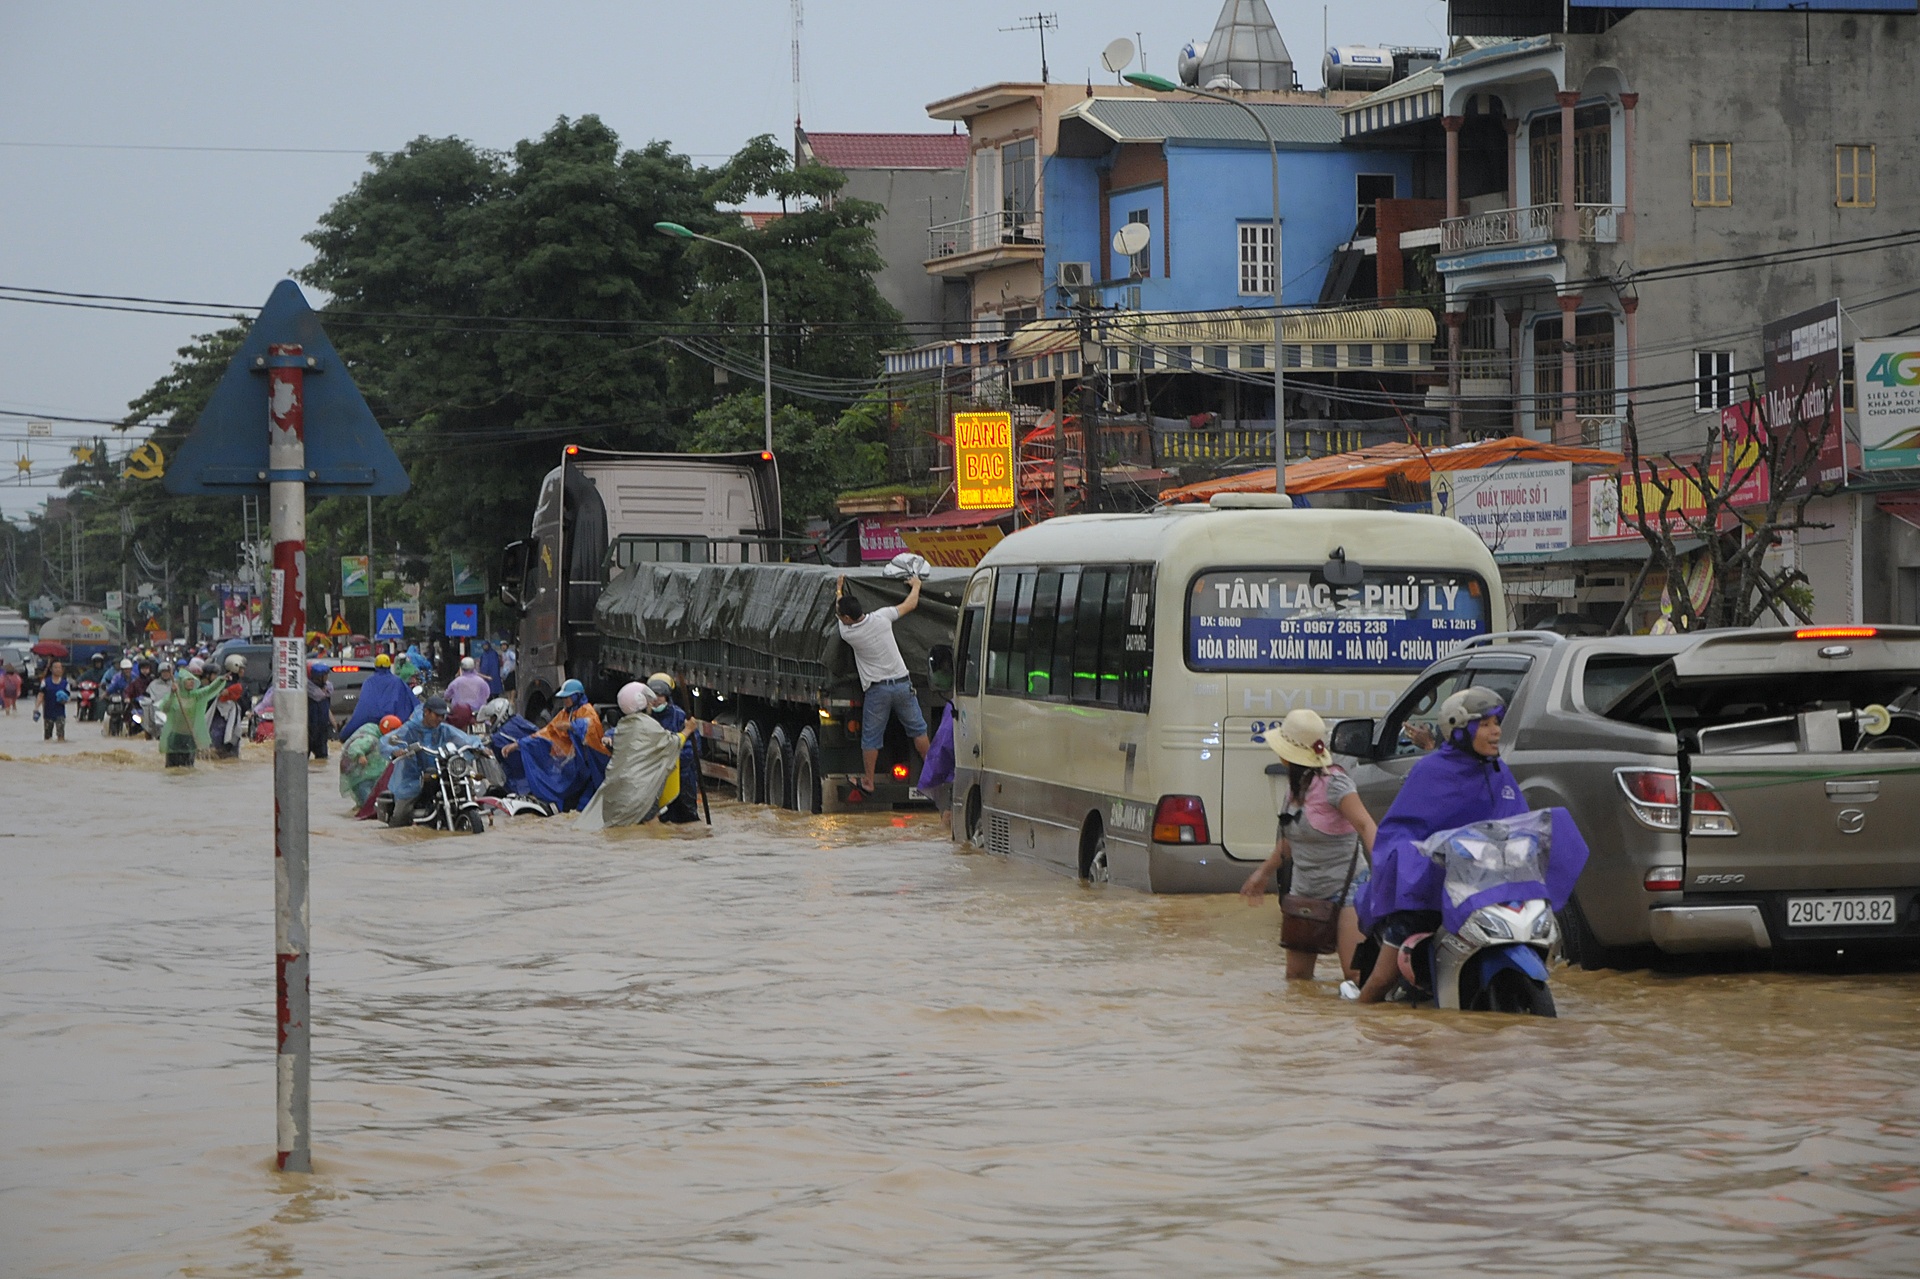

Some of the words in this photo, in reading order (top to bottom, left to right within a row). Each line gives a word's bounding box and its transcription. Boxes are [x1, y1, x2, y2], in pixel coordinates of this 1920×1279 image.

[1866, 351, 1920, 388] 4G
[958, 417, 1008, 449] VÀNG
[965, 452, 1004, 486] BẠC
[1529, 481, 1541, 504] SỐ
[1543, 487, 1548, 504] 1
[1214, 577, 1270, 609] TÂN
[1364, 575, 1419, 611] PHỦ
[1428, 579, 1459, 611] LÝ
[1200, 616, 1216, 627] BX:
[1280, 620, 1301, 634] ĐT:
[1303, 620, 1335, 634] 0967
[1338, 620, 1362, 634] 265
[1364, 620, 1388, 634] 238
[1431, 618, 1447, 630] BX:
[1449, 618, 1477, 630] 12h15
[1197, 634, 1224, 659] HÒA
[1227, 634, 1258, 660] BÌNH
[1269, 634, 1305, 660] XUÂN
[1308, 638, 1333, 660] MAI
[1345, 635, 1363, 660] HÀ
[1366, 636, 1388, 664] NỘI
[1400, 635, 1433, 660] CHÙA
[1242, 687, 1398, 712] HYUND
[1694, 873, 1746, 885] BT-50
